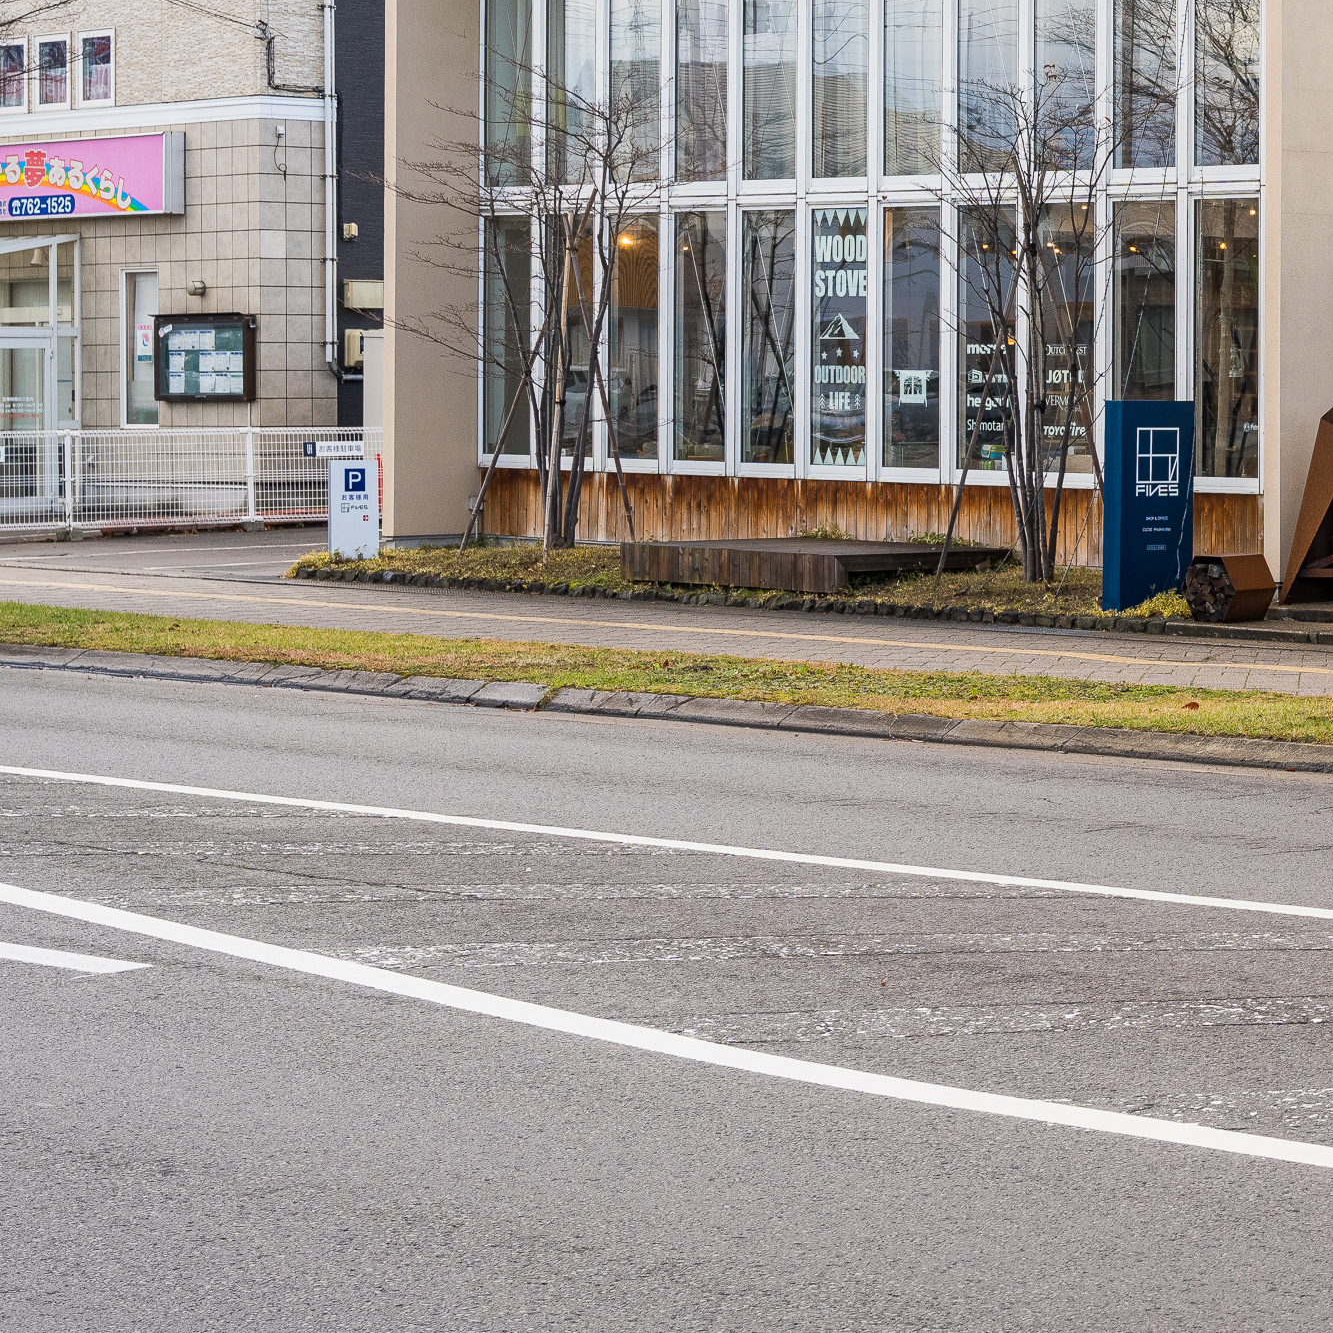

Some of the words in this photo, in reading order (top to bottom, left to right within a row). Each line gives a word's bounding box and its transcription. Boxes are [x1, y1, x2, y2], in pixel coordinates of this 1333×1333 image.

[0, 149, 132, 210] る夢あるくらし
[21, 196, 72, 214] 762-1525
[814, 235, 867, 263] WOOD
[815, 269, 867, 298] STOVE
[814, 365, 866, 384] OUTDOOR
[1046, 370, 1083, 384] JØTL
[828, 392, 851, 410] LIFE
[348, 471, 362, 490] P
[1135, 484, 1179, 497] FIVES
